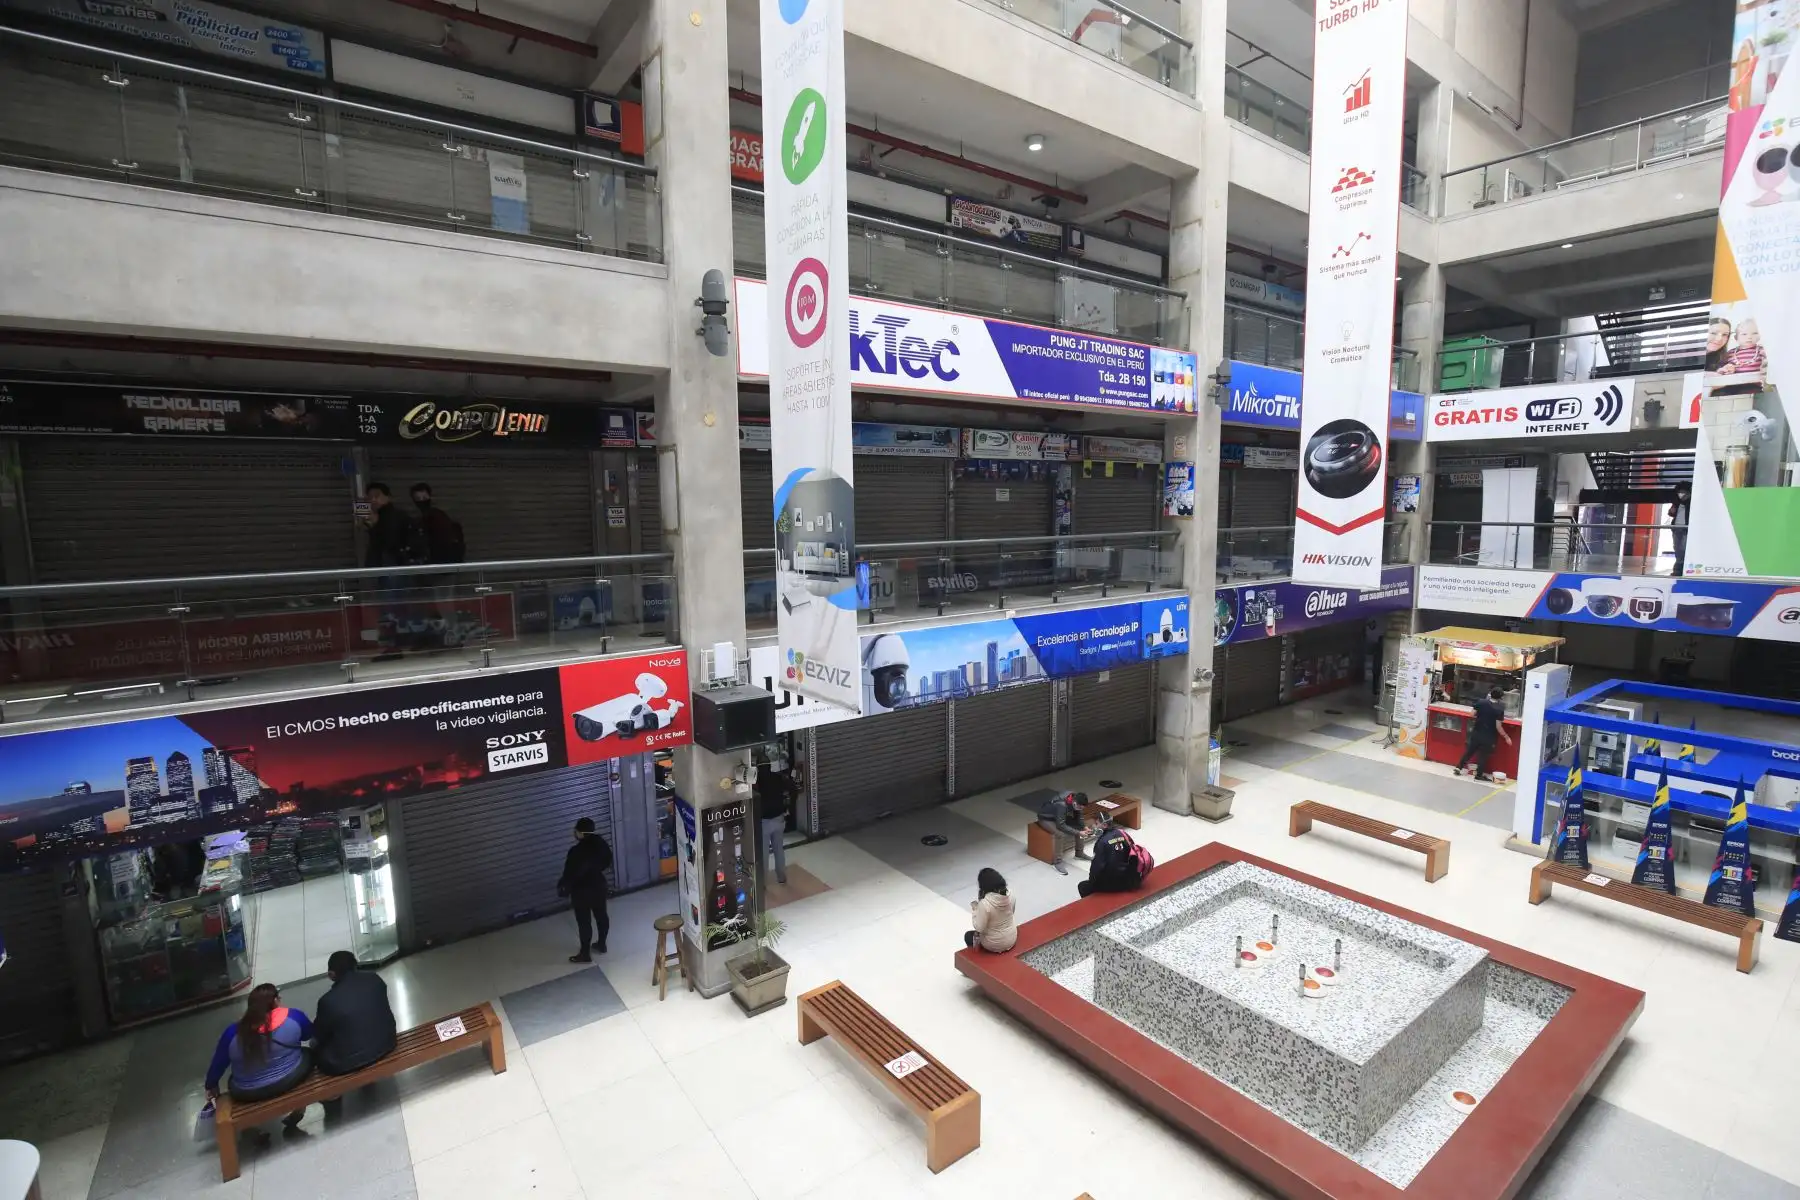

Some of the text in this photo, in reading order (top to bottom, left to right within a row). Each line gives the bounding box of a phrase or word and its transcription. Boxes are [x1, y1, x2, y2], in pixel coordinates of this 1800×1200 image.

[176, 11, 259, 41] Publicidad
[1319, 5, 1358, 32] TURBO
[1050, 334, 1145, 359] PUNG JT TRADING SAC
[1012, 343, 1145, 371] IMPORTADOR EXCLUSIVO EN EL PERÚ
[1099, 370, 1146, 387] Tda. 2B 150
[357, 404, 384, 415] TDA.
[358, 415, 376, 424] 1-A
[1434, 406, 1519, 427] GRATIS
[358, 424, 378, 434] 129
[1525, 422, 1590, 434] INTERNET
[1302, 554, 1373, 567] HIKVISION
[1423, 575, 1461, 584] Permitiendo
[1477, 579, 1510, 587] sociedad
[1037, 622, 1139, 647] Excelencia en Tecnología IP
[266, 690, 544, 738] El CMOS hecho específicamente para
[435, 705, 547, 731] la video vigilancia.
[486, 729, 546, 749] SONY
[492, 748, 544, 767] STARVIS
